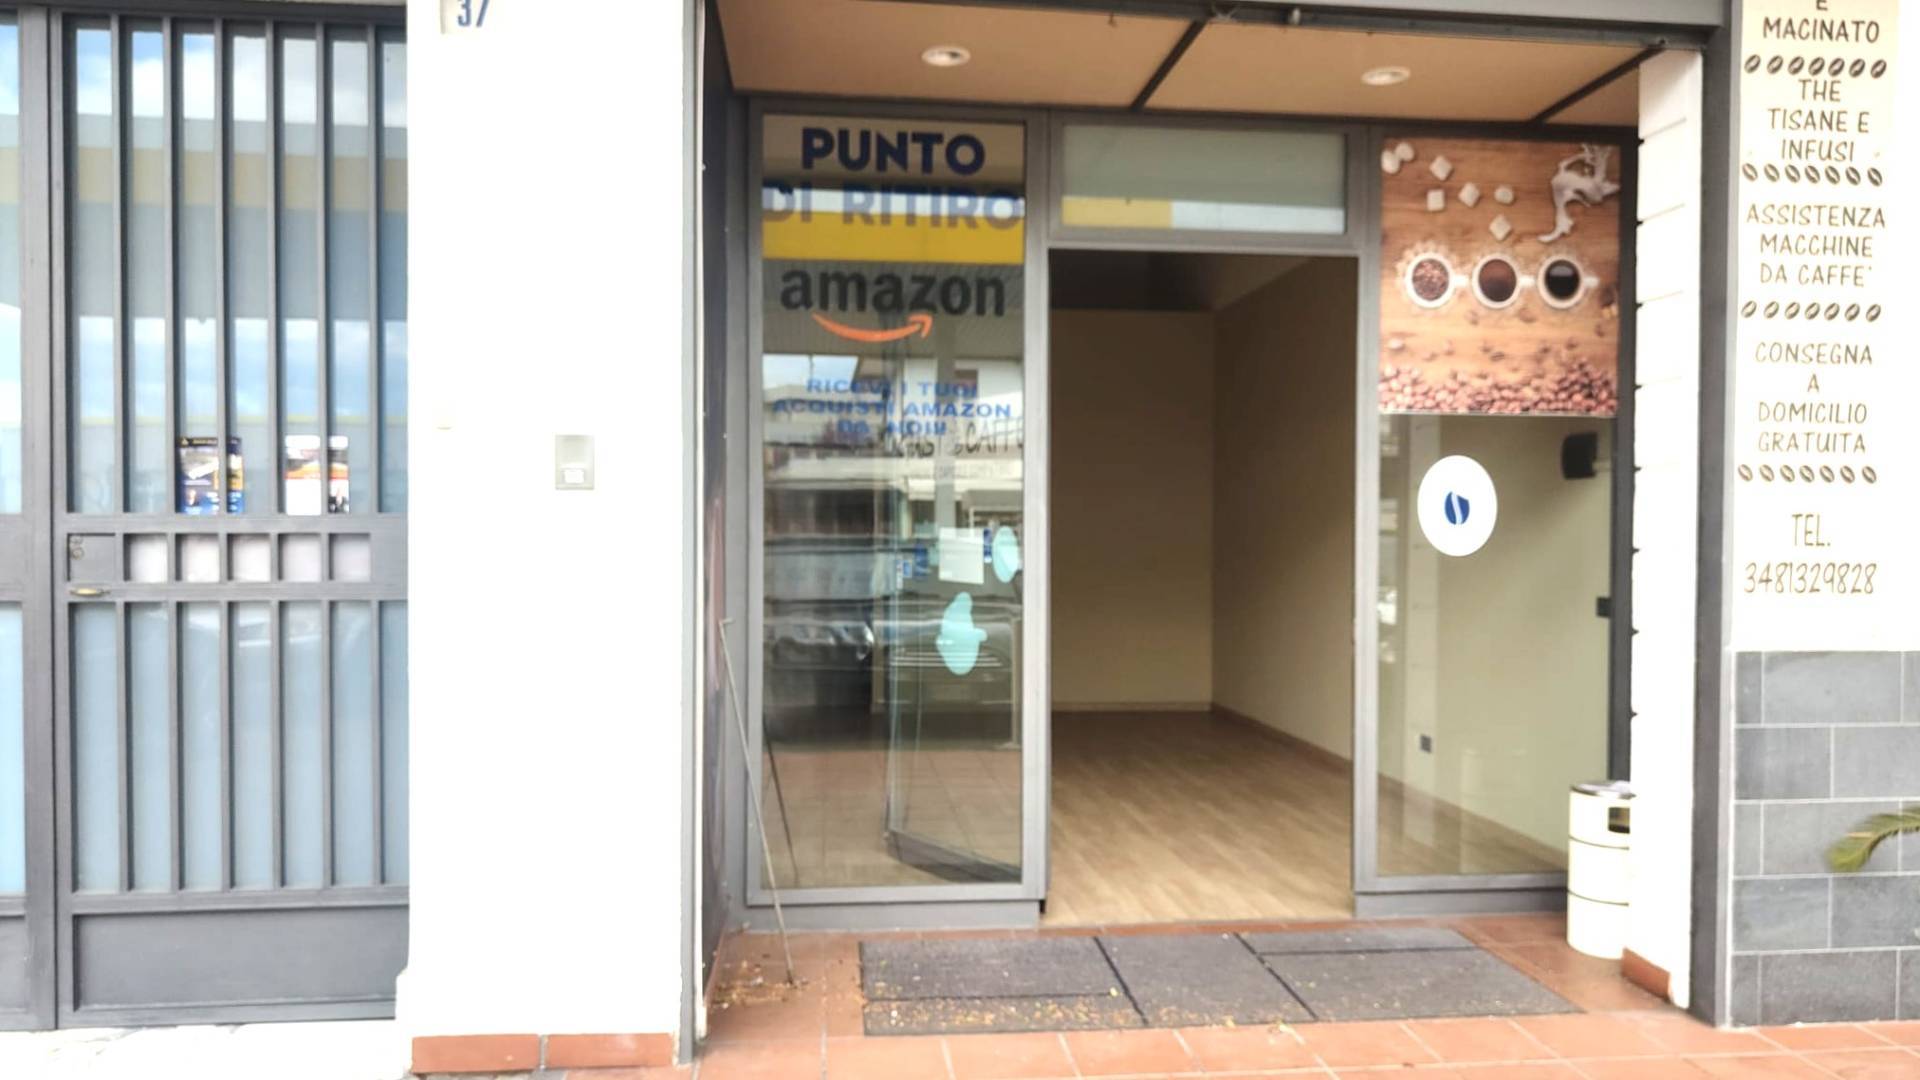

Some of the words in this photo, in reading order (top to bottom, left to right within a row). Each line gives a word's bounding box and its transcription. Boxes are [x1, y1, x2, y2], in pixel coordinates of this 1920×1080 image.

[1763, 16, 1880, 43] MACINATO
[1799, 79, 1842, 102] THE
[1768, 108, 1848, 132] TISANE
[1858, 111, 1870, 133] E
[802, 127, 986, 176] PUNTO
[1781, 138, 1854, 162] INFUSI
[762, 181, 812, 223] DI
[842, 183, 1023, 230] RITIRO
[1746, 203, 1886, 229] ASSISTENZA
[1760, 233, 1873, 257] MACCHINE
[1760, 262, 1788, 284] DA
[780, 269, 1006, 317] amazon
[1755, 342, 1873, 365] CONSEGNA
[918, 382, 979, 399] TUOI
[1807, 373, 1820, 393] A
[773, 398, 894, 415] ACQUISTI
[903, 402, 1012, 418] AMAZON
[1758, 402, 1868, 424] DOMICILIO
[837, 419, 871, 434] DA
[1757, 431, 1867, 453] GRATUITA
[1792, 513, 1832, 546] TEL.
[1743, 562, 1878, 594] 3481329828
